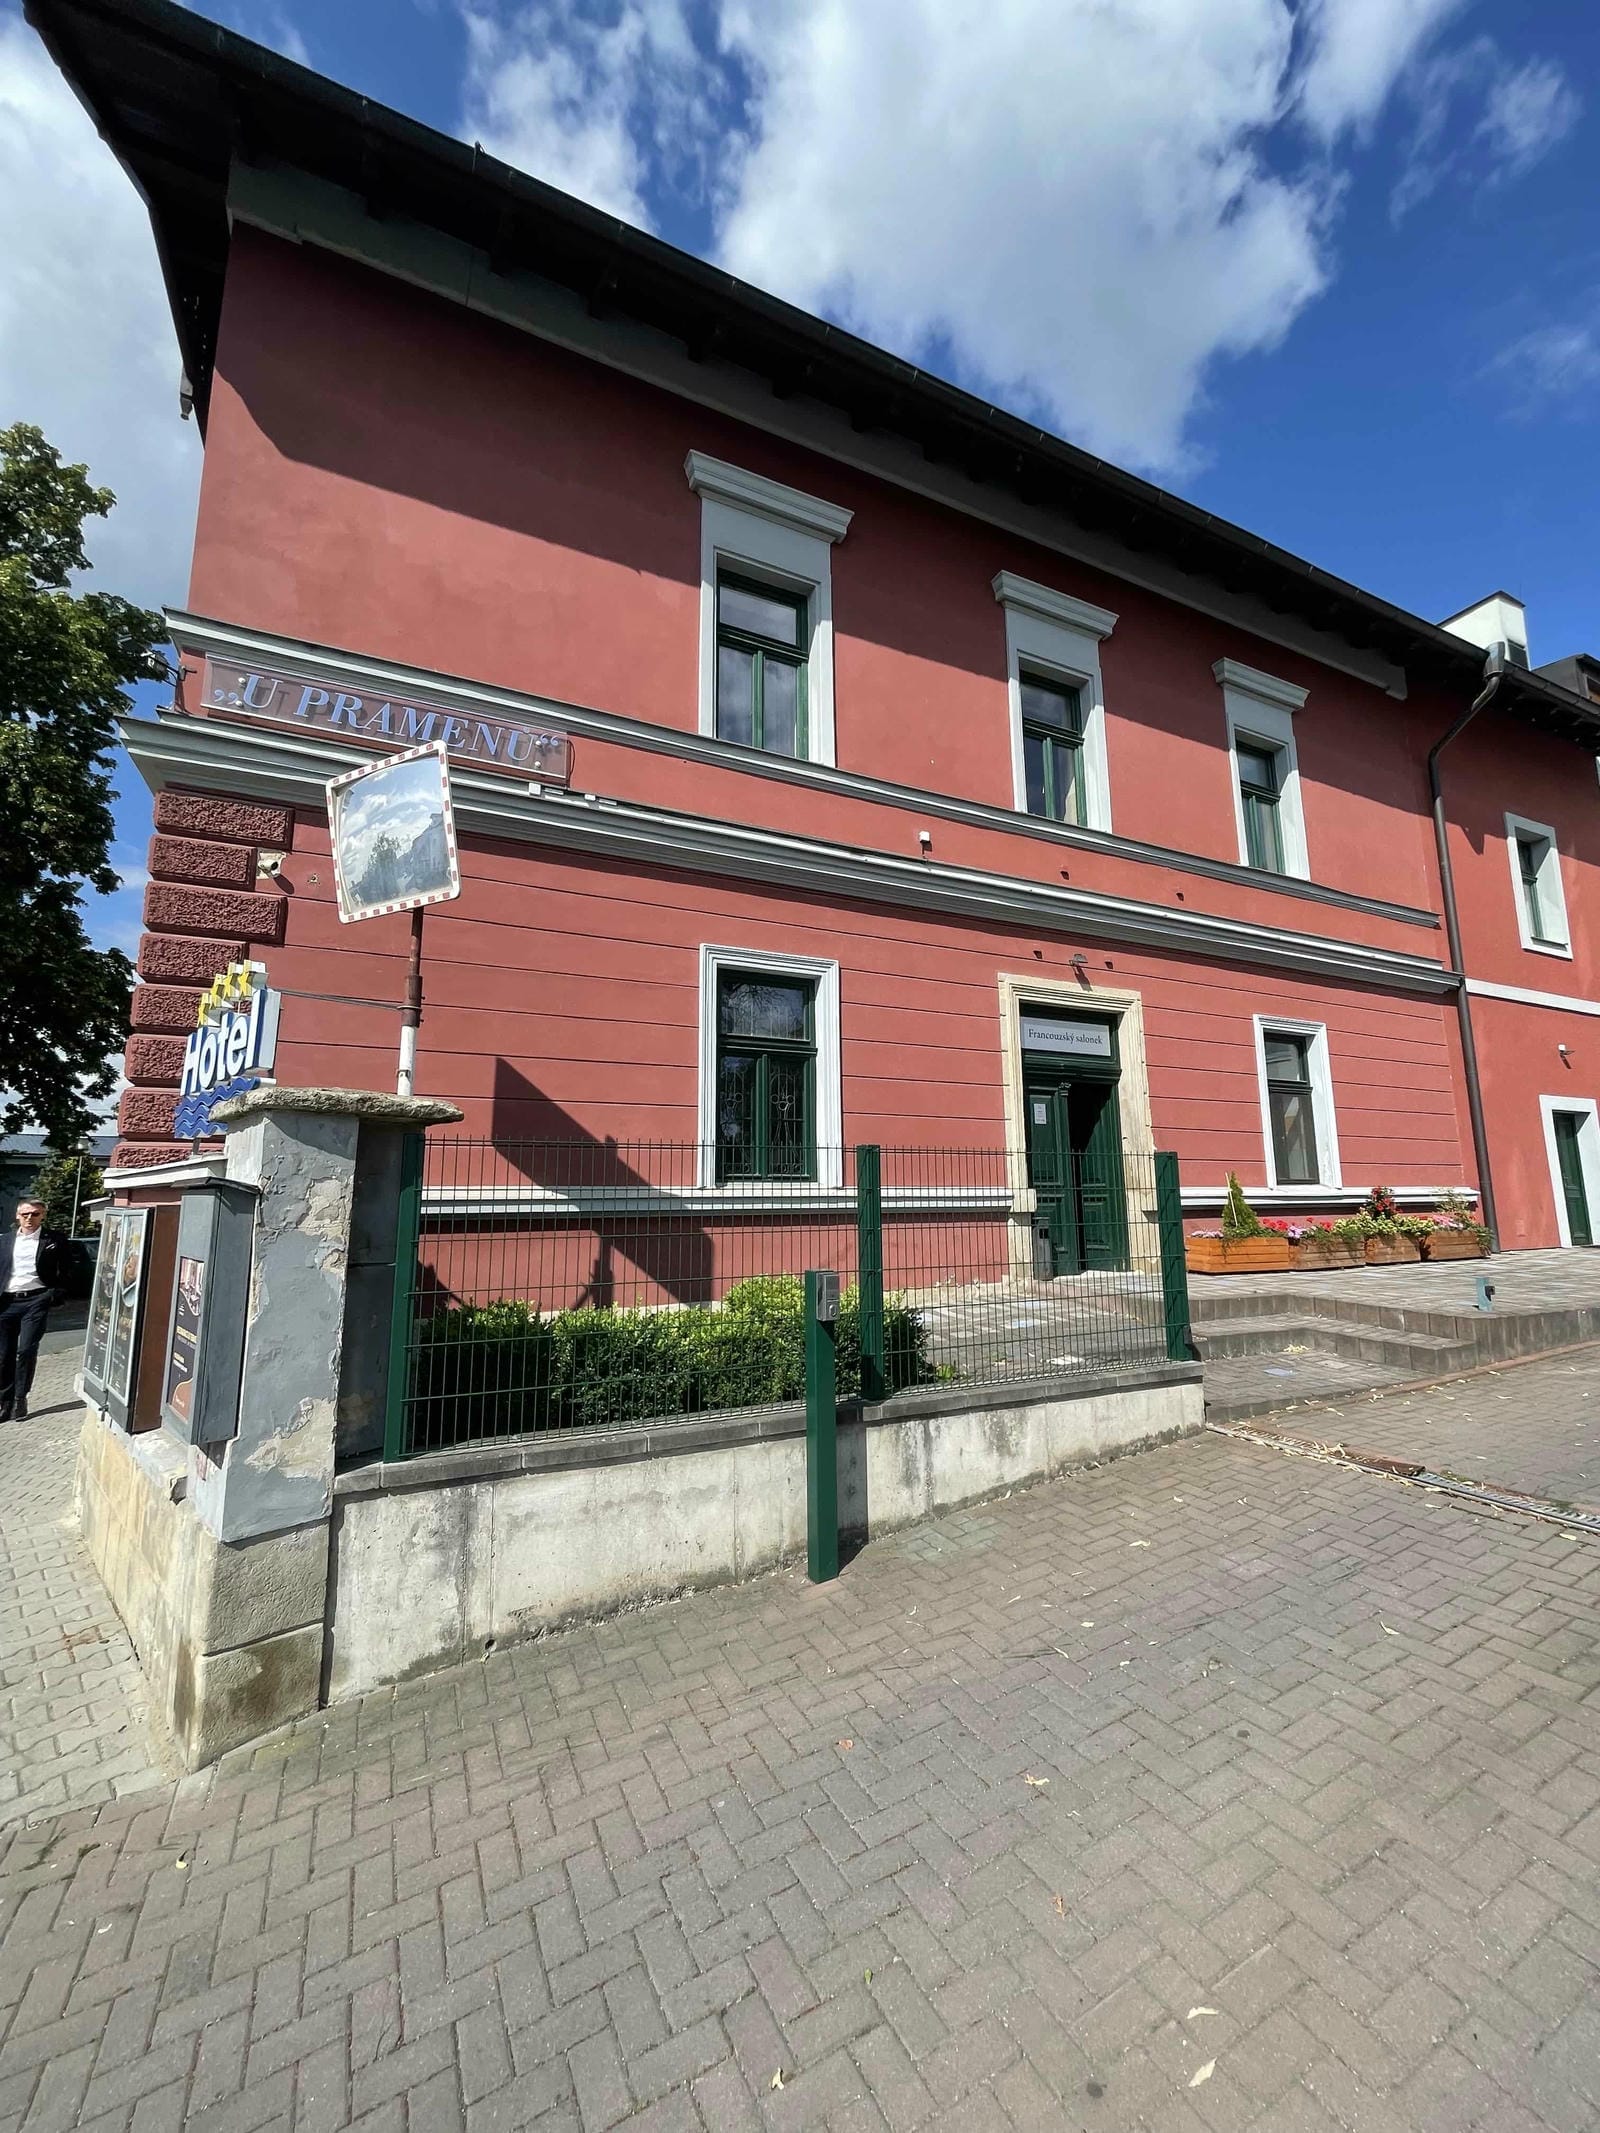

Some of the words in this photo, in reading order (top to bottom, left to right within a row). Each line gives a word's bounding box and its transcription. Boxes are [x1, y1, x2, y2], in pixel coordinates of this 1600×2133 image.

[180, 988, 264, 1097] Hotel
[1028, 1028, 1075, 1045] Francouzský
[1075, 1034, 1103, 1046] salonek
